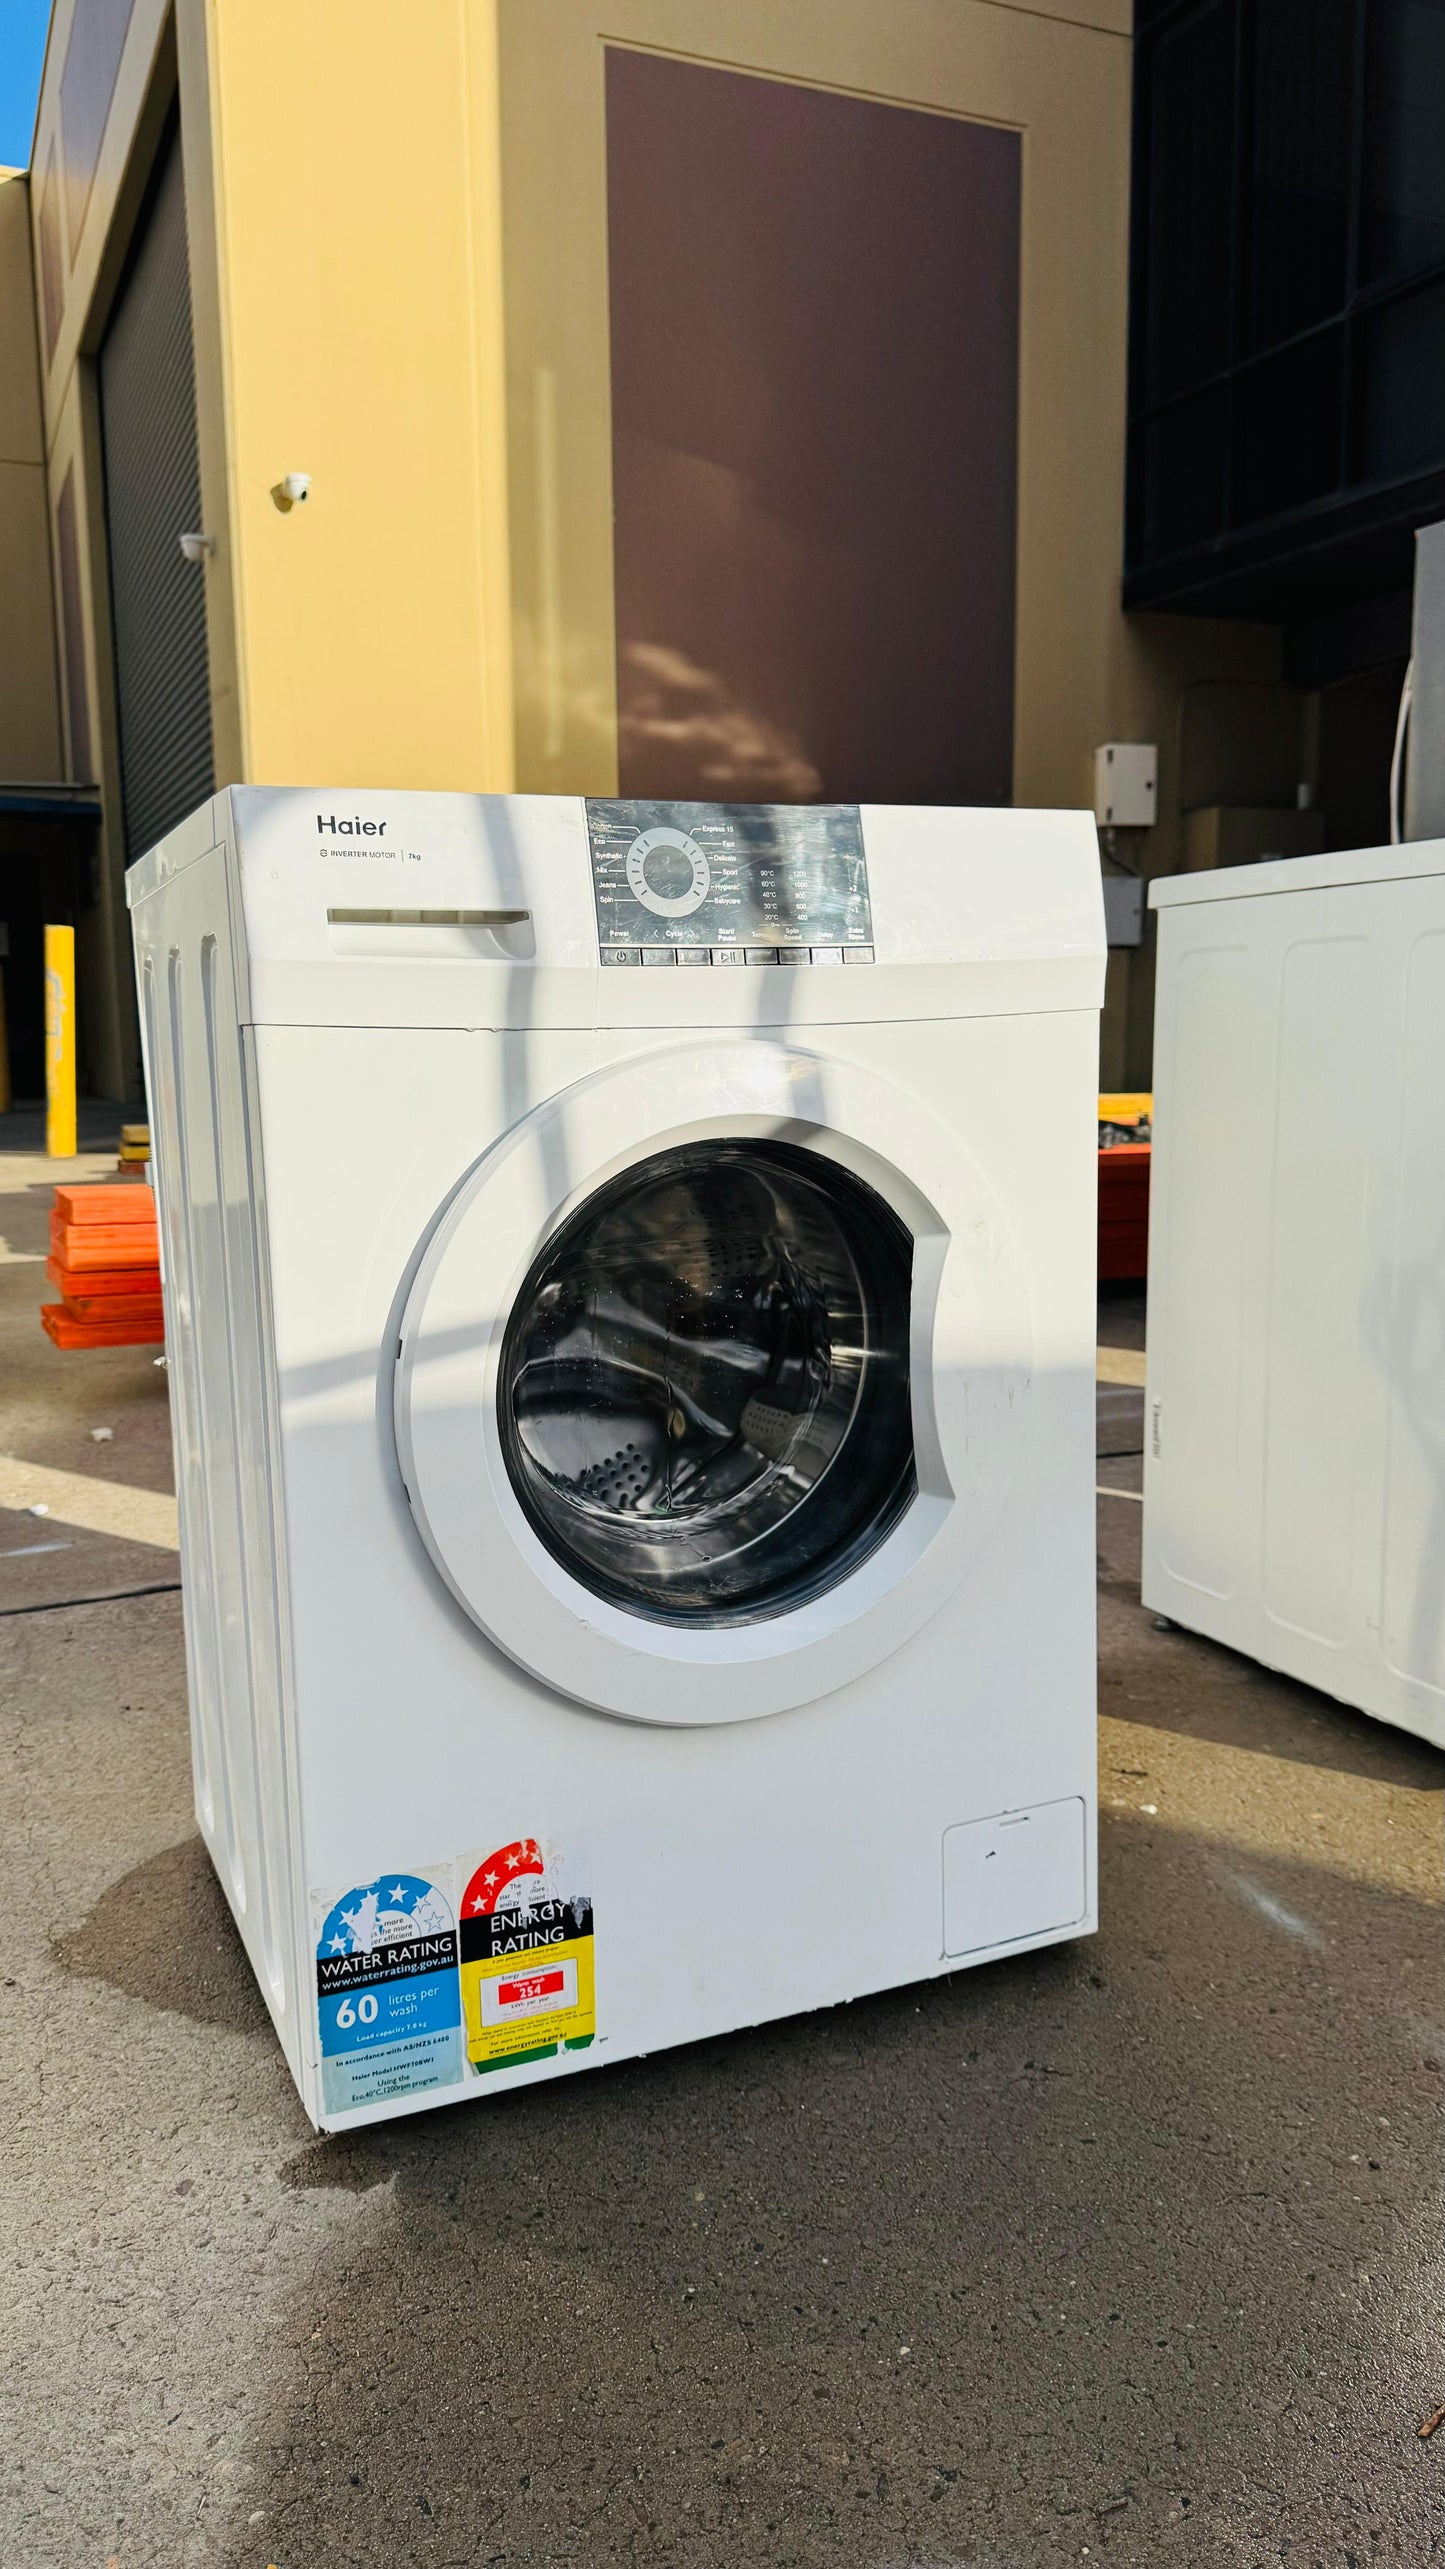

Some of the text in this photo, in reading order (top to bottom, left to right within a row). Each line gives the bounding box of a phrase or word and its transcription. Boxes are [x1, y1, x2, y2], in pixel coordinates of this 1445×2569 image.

[317, 815, 387, 836] Haier
[702, 825, 725, 833] Express
[593, 837, 606, 845] Eco
[330, 850, 368, 858] INVERTER
[369, 851, 396, 859] MOTOR
[595, 852, 623, 860] Synthetic
[713, 854, 737, 862] Delicate
[722, 868, 738, 876] Sport
[760, 869, 775, 877] 90°C
[792, 870, 807, 878] 1200
[599, 881, 617, 889] Jeans
[761, 880, 776, 888] 60°C
[600, 895, 614, 904] Spin
[714, 896, 741, 905] Babycare
[763, 902, 778, 910] 30°C
[764, 913, 779, 921] 20°C
[665, 930, 684, 938] Cycle
[783, 933, 803, 941] Speed
[491, 1902, 566, 1933] ENERGY
[384, 1918, 404, 1927] more
[381, 1928, 393, 1936] he
[393, 1924, 413, 1933] more
[383, 1931, 413, 1943] efficient
[491, 1926, 565, 1957] RATING
[321, 1953, 383, 1978] WATER
[387, 1937, 453, 1965] RATING
[321, 1955, 454, 1991] www.waterrating.gov.au
[501, 1974, 520, 1982] Energy
[519, 1983, 542, 2000] 254
[336, 1986, 440, 2029] 60 litres per
[389, 2003, 418, 2018] wash
[356, 2032, 375, 2043] Load
[375, 2026, 405, 2038] capacity
[336, 2060, 344, 2068] In
[344, 2051, 385, 2066] accordance
[386, 2047, 402, 2057] with
[351, 2073, 371, 2082] Haier
[371, 2067, 393, 2077] Model
[377, 2078, 398, 2087] Using
[411, 2076, 439, 2089] program
